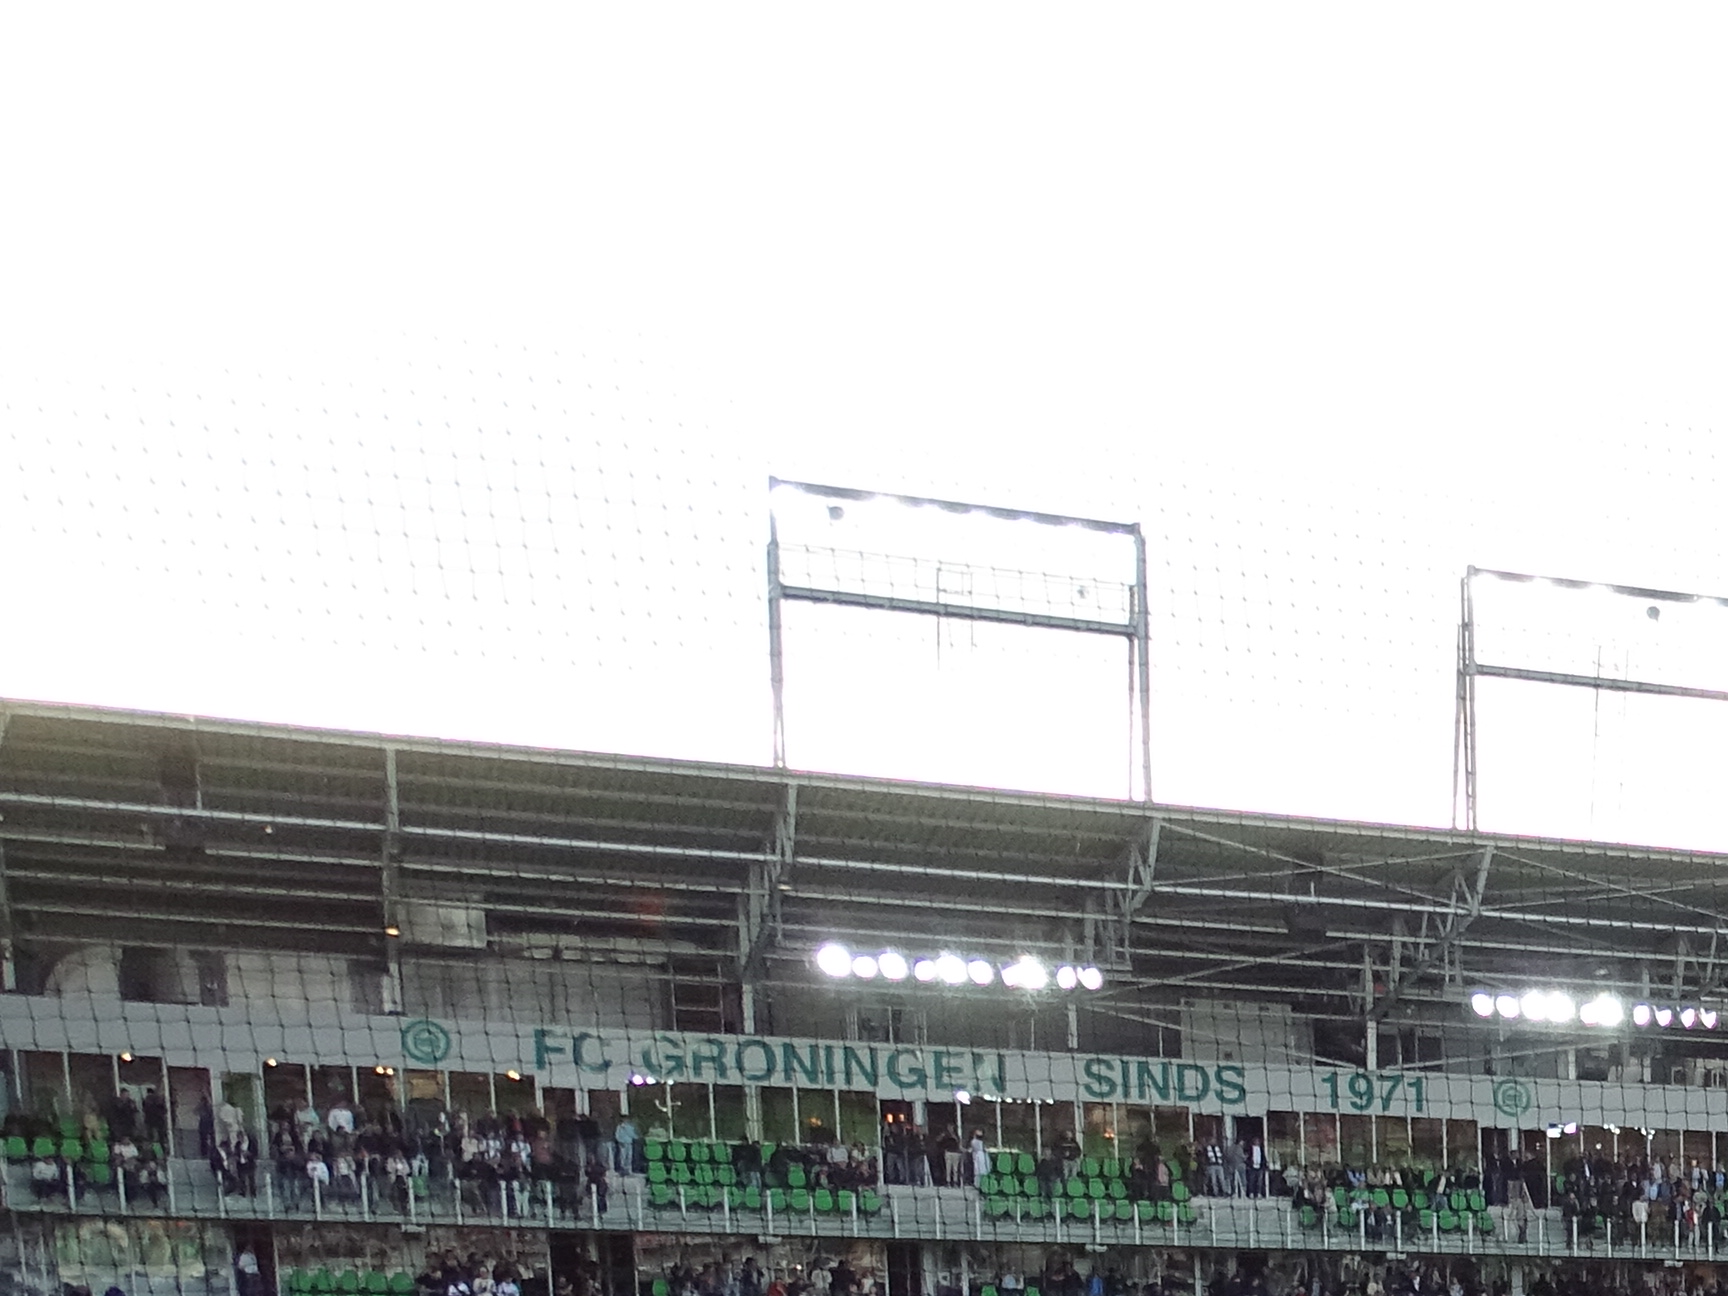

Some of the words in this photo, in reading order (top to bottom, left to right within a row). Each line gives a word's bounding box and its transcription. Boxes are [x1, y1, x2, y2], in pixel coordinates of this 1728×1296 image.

[534, 1028, 611, 1073] FC
[641, 1034, 1007, 1094] GRONINGEN
[1083, 1058, 1246, 1105] SINDS
[1322, 1071, 1426, 1113] 1971
